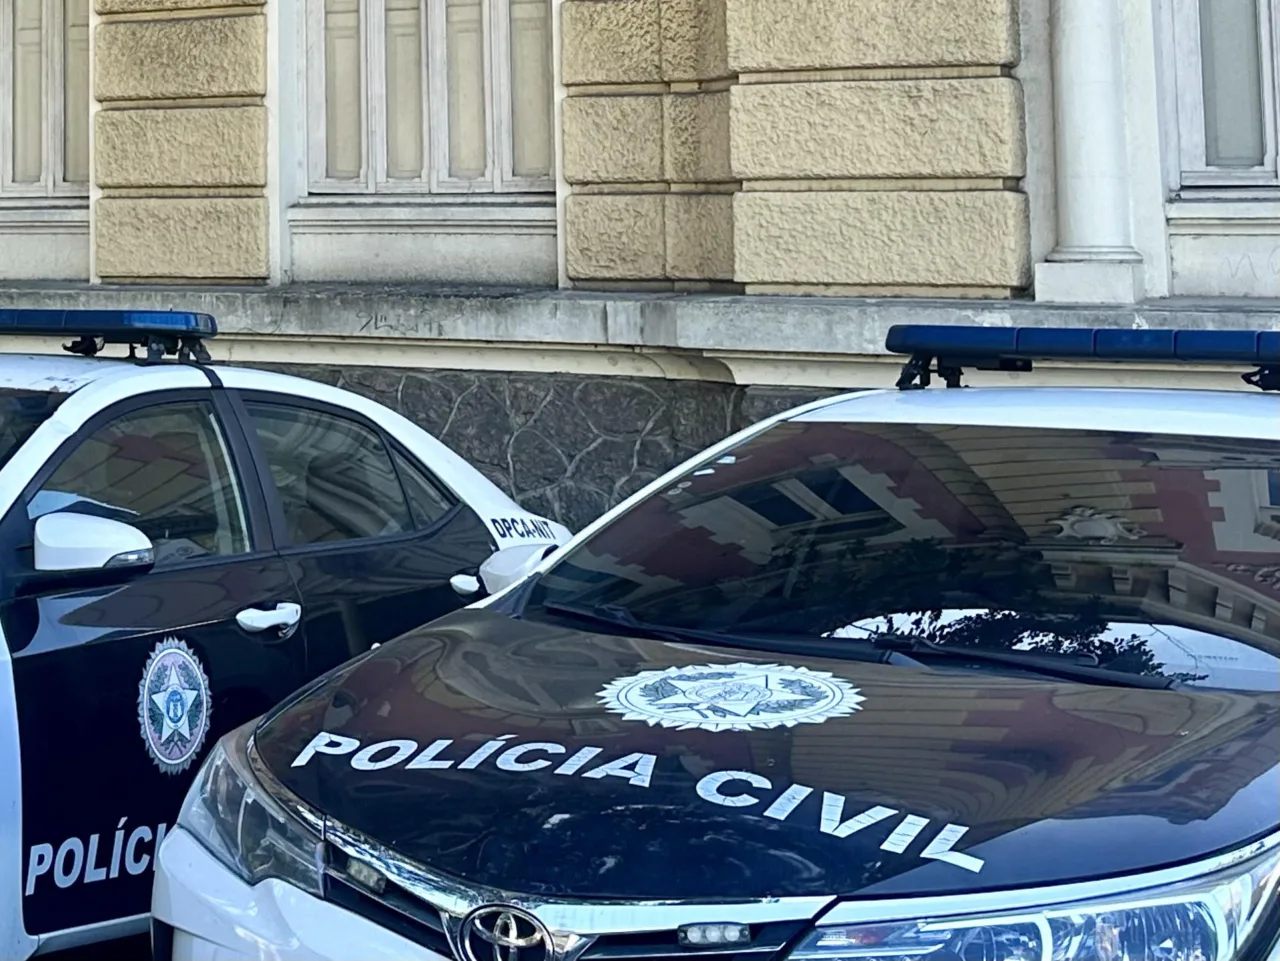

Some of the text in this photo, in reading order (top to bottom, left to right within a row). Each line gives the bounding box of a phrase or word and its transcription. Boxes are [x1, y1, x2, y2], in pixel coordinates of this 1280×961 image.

[491, 518, 556, 540] DPCA-NIT
[291, 731, 986, 873] POLÍCIA CIVIL
[24, 816, 168, 897] POLÍCI
